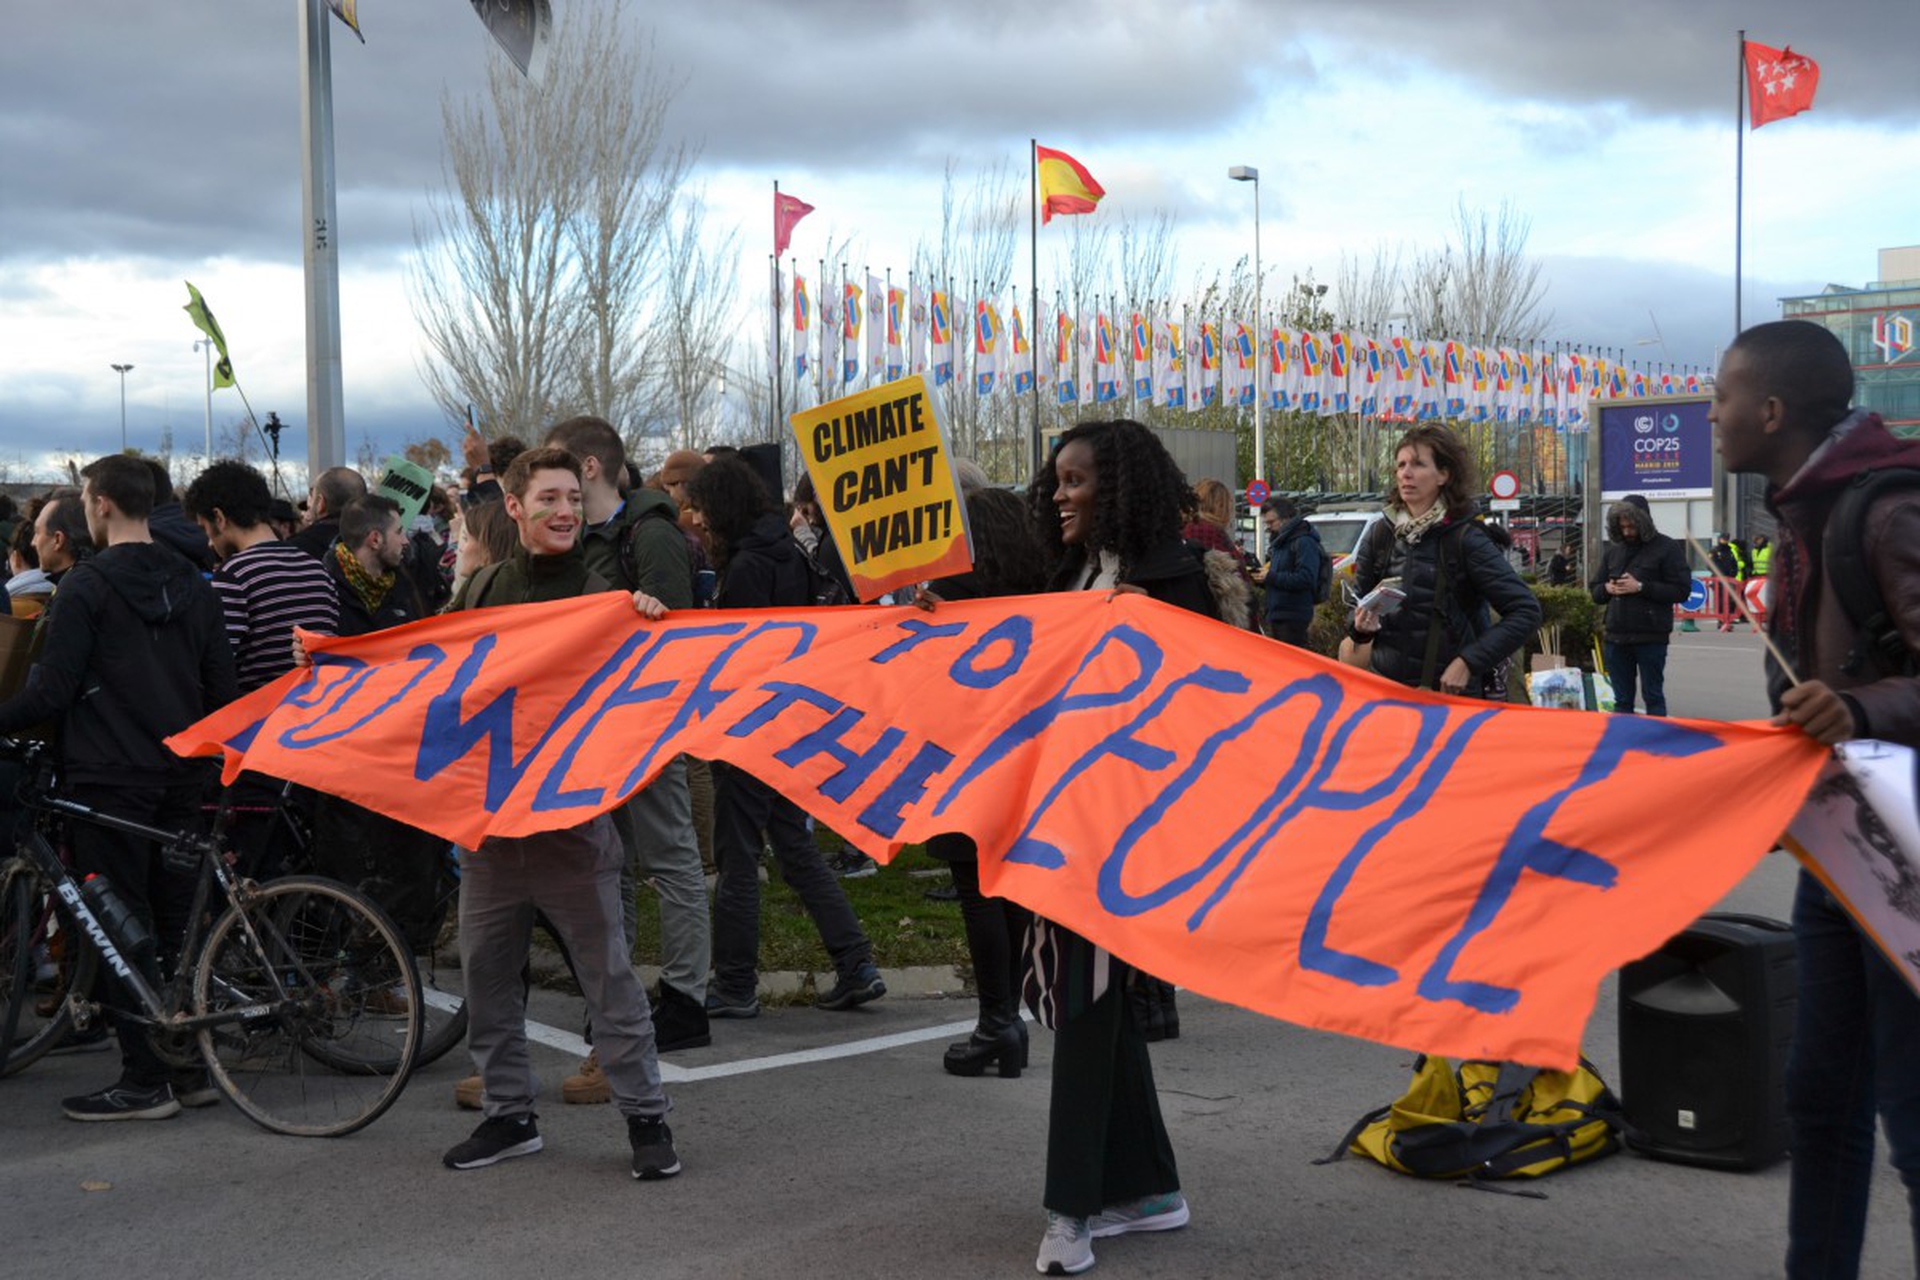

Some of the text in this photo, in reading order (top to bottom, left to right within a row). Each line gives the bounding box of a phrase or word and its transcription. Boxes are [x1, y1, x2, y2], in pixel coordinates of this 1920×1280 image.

[813, 392, 924, 463] CLIMATE
[1634, 437, 1680, 453] COP25
[833, 446, 938, 512] CAN'T
[851, 500, 952, 565] WAIT!
[871, 614, 1033, 689] TO
[724, 681, 955, 839] THE
[931, 624, 1724, 1014] PEOPLE
[57, 882, 131, 977] B'TWIN
